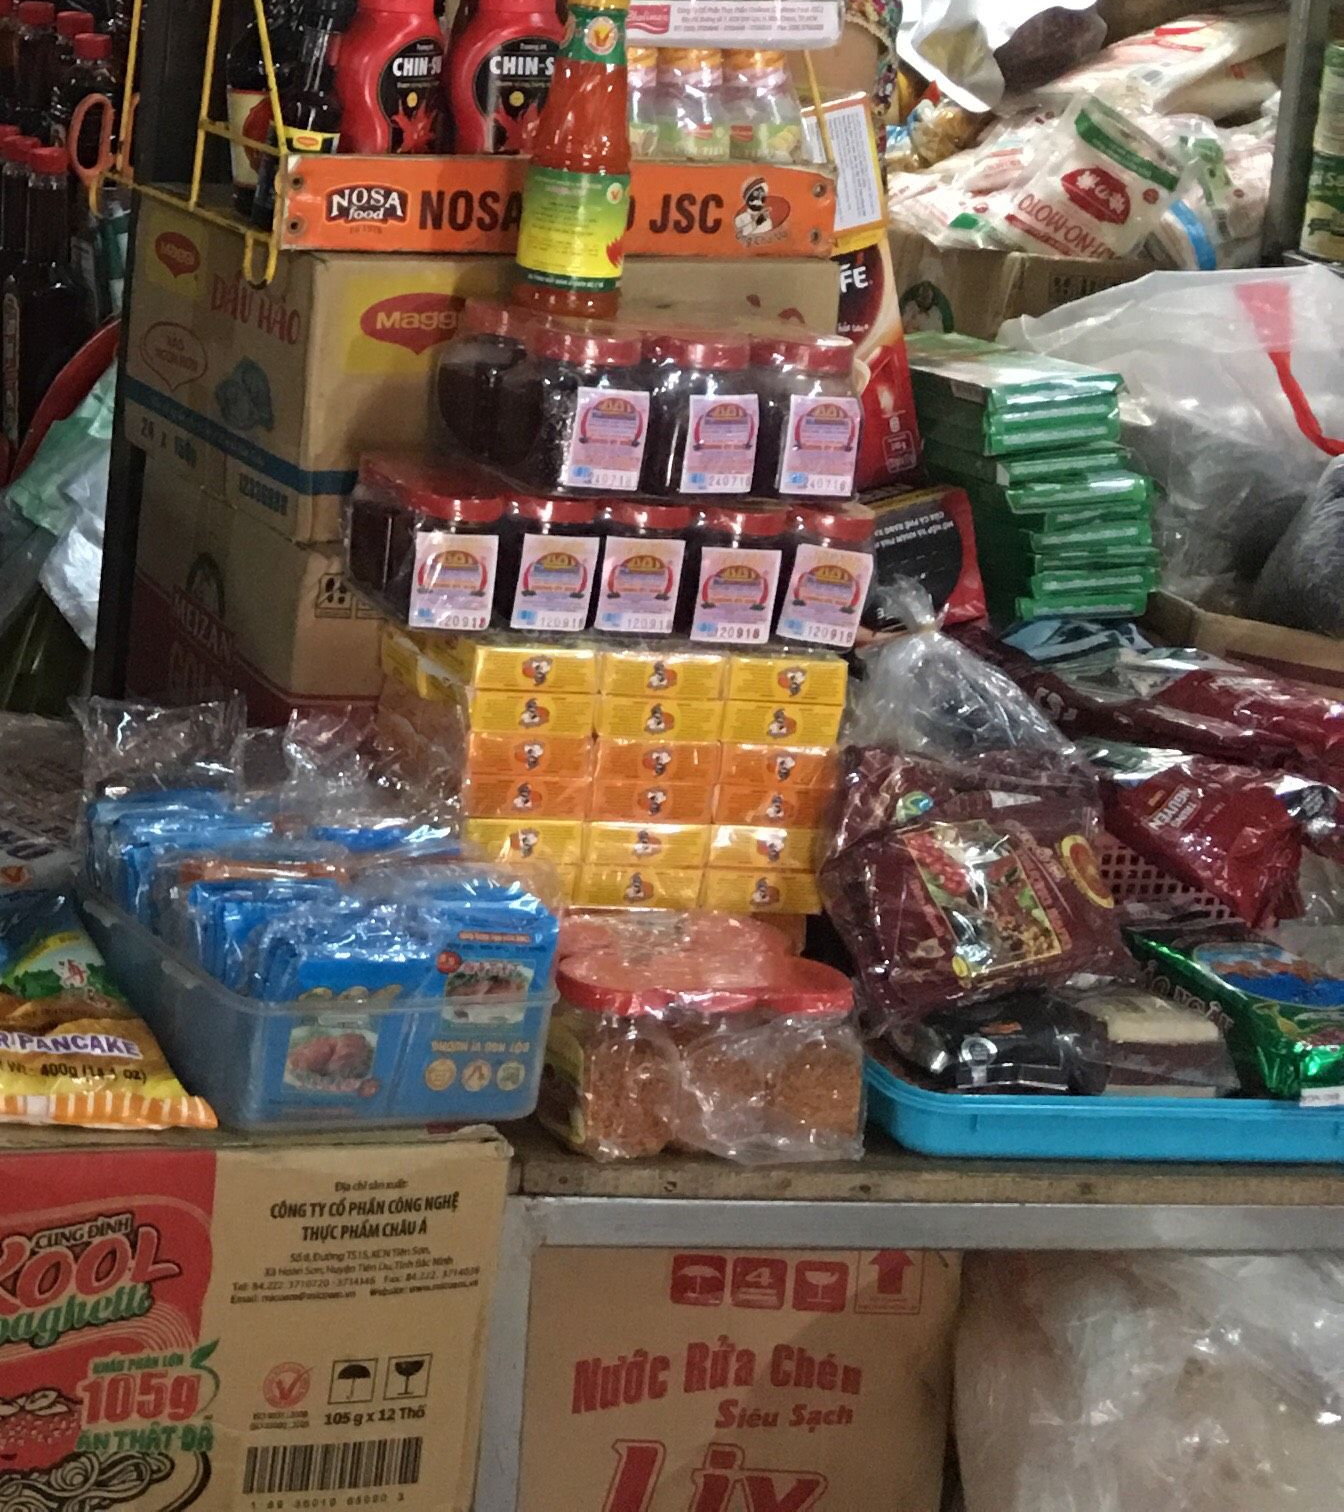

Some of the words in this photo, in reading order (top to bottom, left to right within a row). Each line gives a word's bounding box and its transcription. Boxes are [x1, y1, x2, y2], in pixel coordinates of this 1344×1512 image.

[489, 55, 555, 77] CHIN-S
[330, 187, 404, 218] NOSA
[347, 207, 385, 221] food
[649, 192, 725, 235] JSC
[375, 310, 459, 331] Magg
[18, 1032, 144, 1060] PANCAKE
[40, 1062, 79, 1080] 400g
[270, 1199, 308, 1220] CÔNG
[310, 1201, 328, 1219] TY
[328, 1196, 347, 1219] CỔ
[348, 1193, 386, 1217] PHẦN
[387, 1195, 422, 1215] CÔNG
[423, 1190, 460, 1215] NGHỆ
[34, 1226, 86, 1252] CUNG
[86, 1213, 134, 1241] ĐÌNH
[302, 1223, 339, 1245] THỰC
[340, 1218, 381, 1240] PHẨM
[381, 1218, 417, 1239] CHÂU
[418, 1215, 428, 1236] Á
[570, 1348, 672, 1415] Nước
[682, 1334, 758, 1394] Rửa
[769, 1343, 863, 1396] Chén
[79, 1370, 202, 1426] 105g
[324, 1412, 352, 1426] 105
[353, 1413, 364, 1427] g
[365, 1411, 376, 1422] x
[376, 1408, 396, 1421] 12
[714, 1398, 780, 1430] Siêu
[787, 1402, 856, 1435] Sạch
